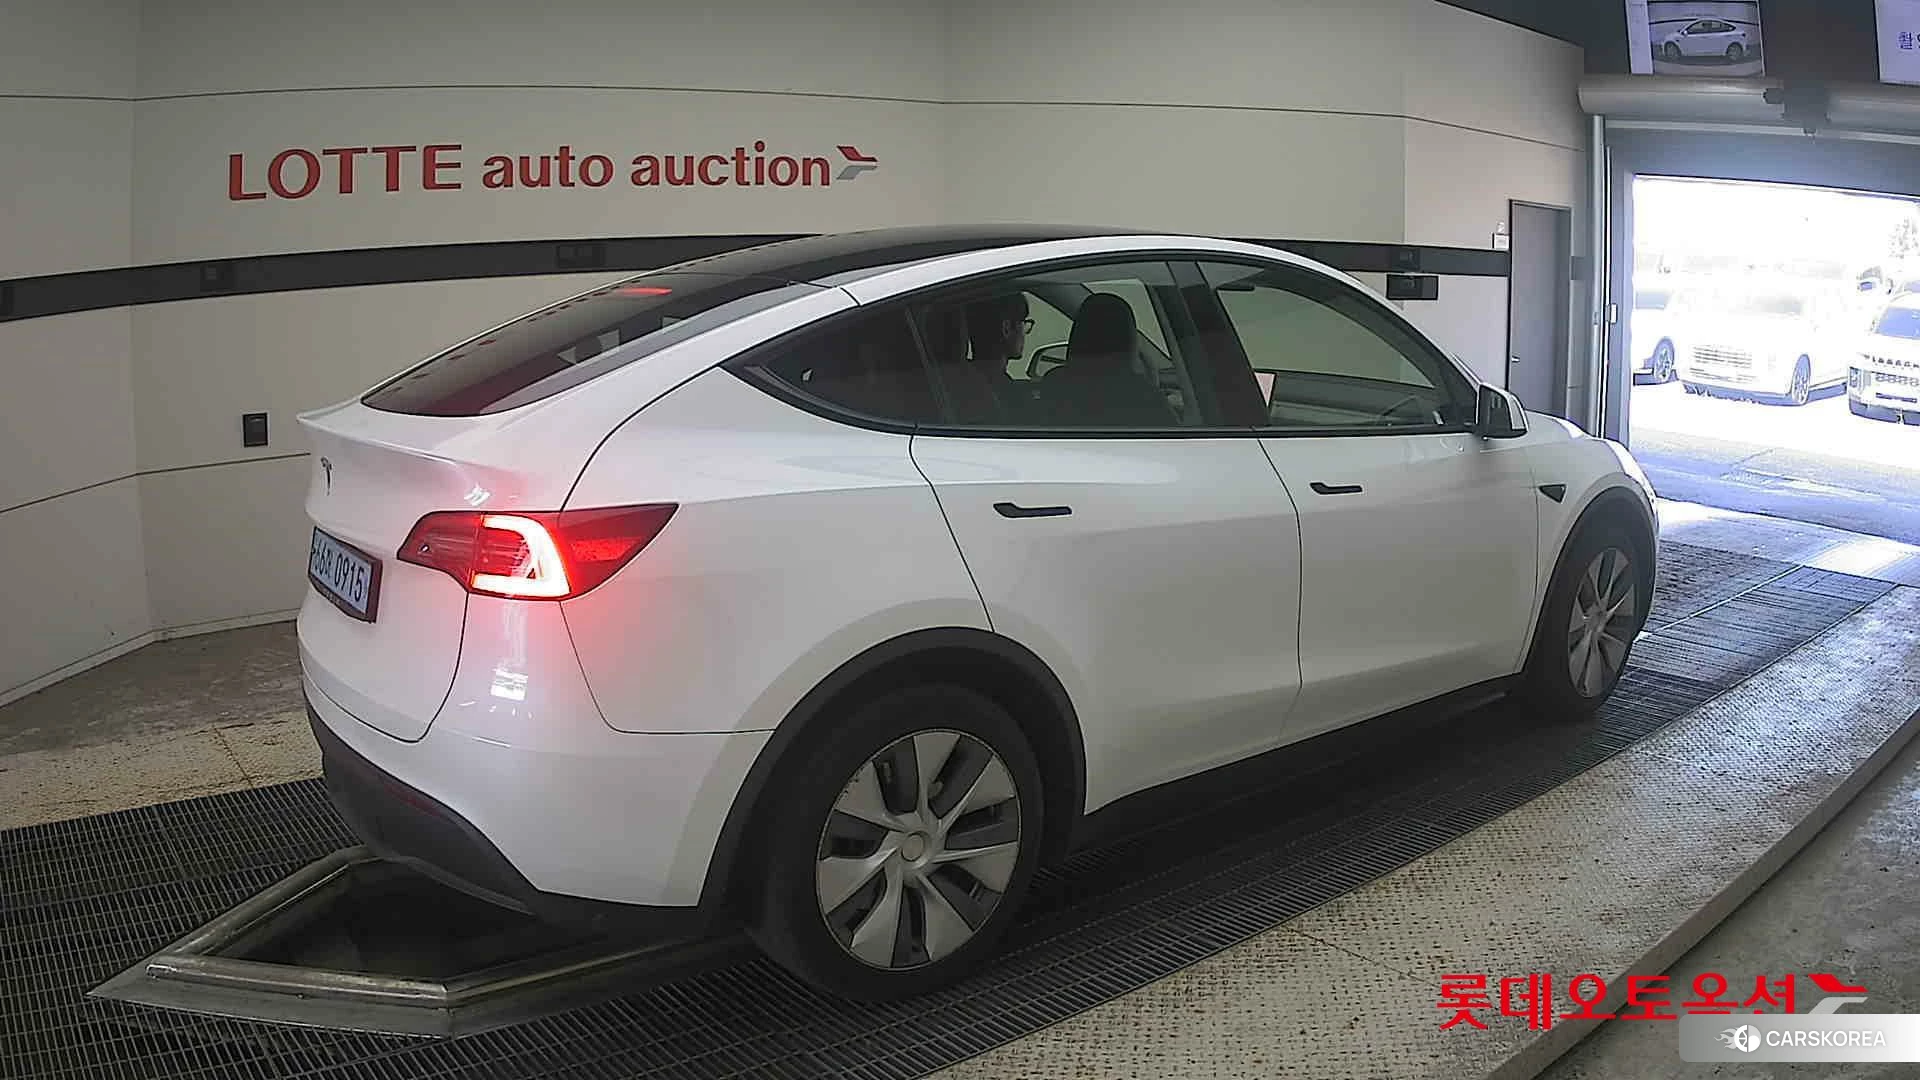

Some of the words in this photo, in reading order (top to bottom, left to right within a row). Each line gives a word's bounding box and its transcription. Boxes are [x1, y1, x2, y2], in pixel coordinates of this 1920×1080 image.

[228, 145, 462, 199] LOTTE
[482, 145, 614, 188] auto
[630, 140, 830, 187] auction
[334, 552, 365, 602] 0915
